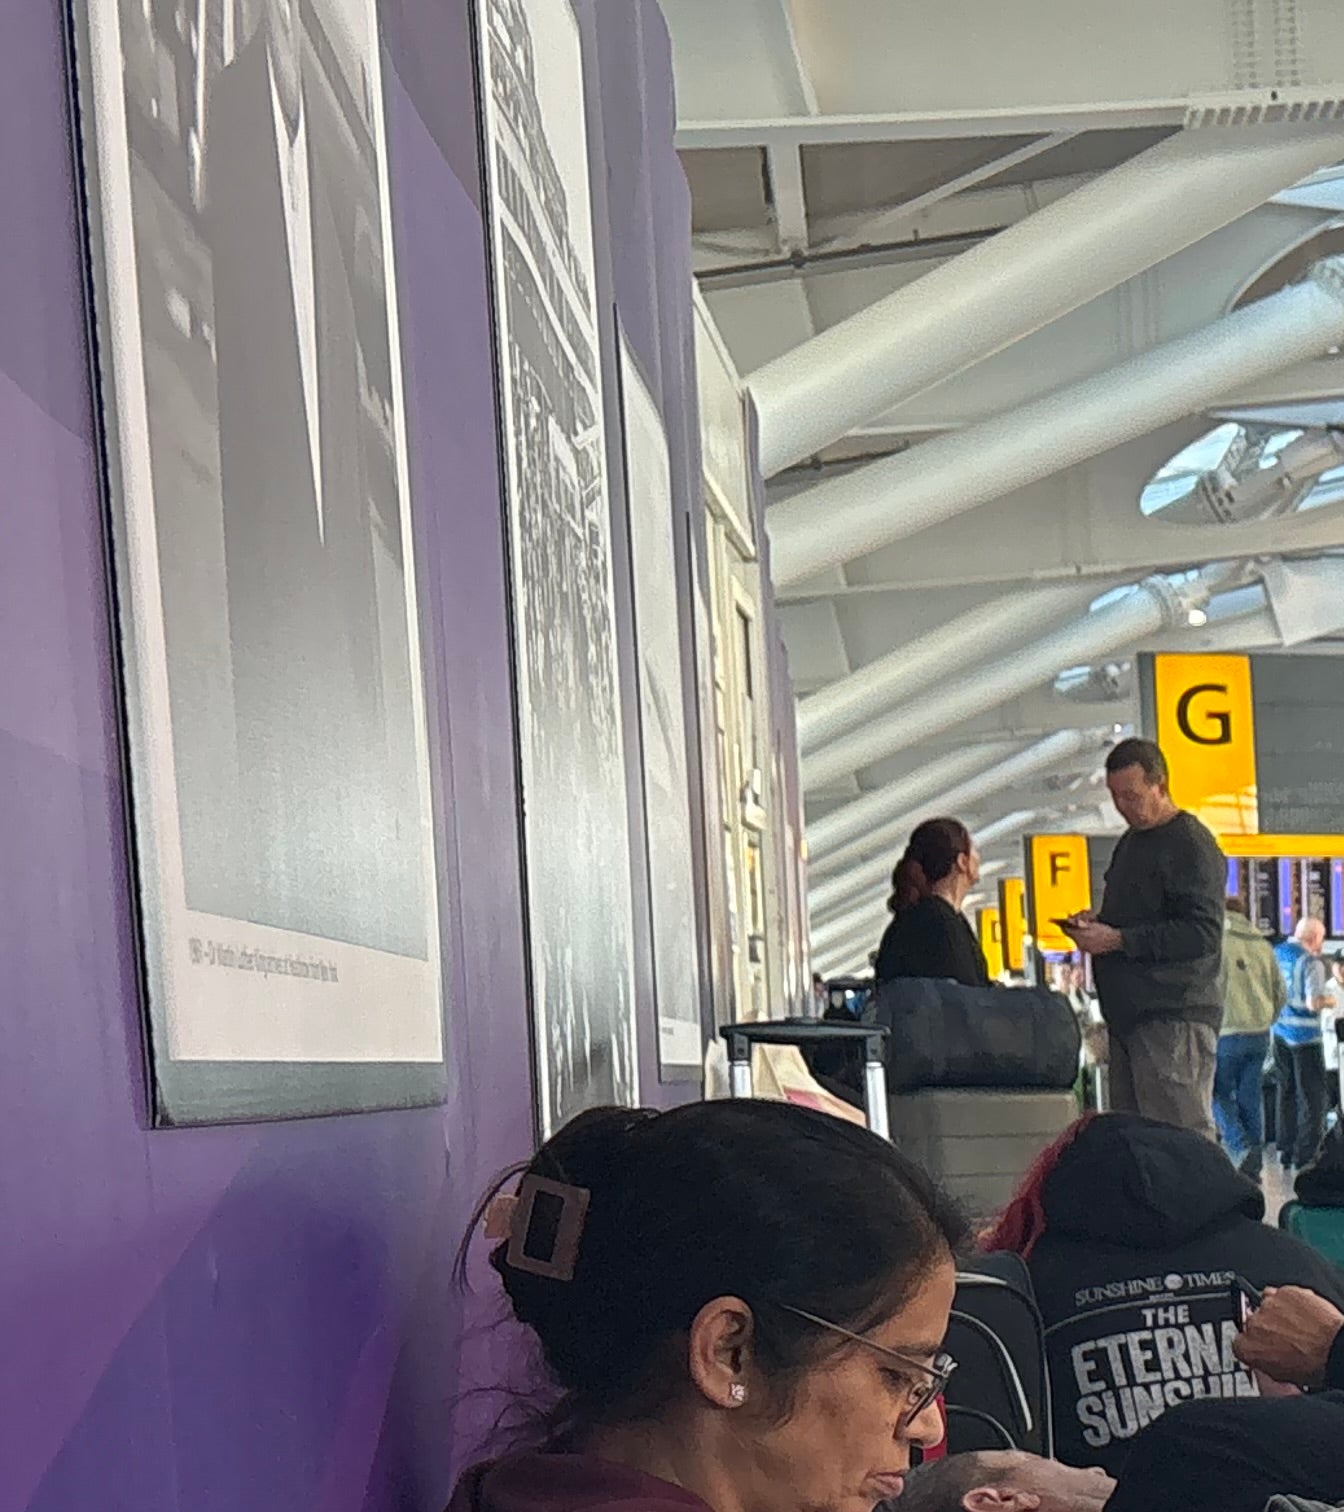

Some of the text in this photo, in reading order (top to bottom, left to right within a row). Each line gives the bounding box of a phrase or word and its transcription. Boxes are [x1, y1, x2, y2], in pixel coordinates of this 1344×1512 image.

[1175, 683, 1233, 746] G
[1049, 851, 1071, 887] F
[1075, 1276, 1164, 1306] SUNSHINE
[1141, 1304, 1190, 1327] THE
[1071, 1319, 1250, 1395] ETERNA
[1076, 1370, 1261, 1448] SUNSHIN
